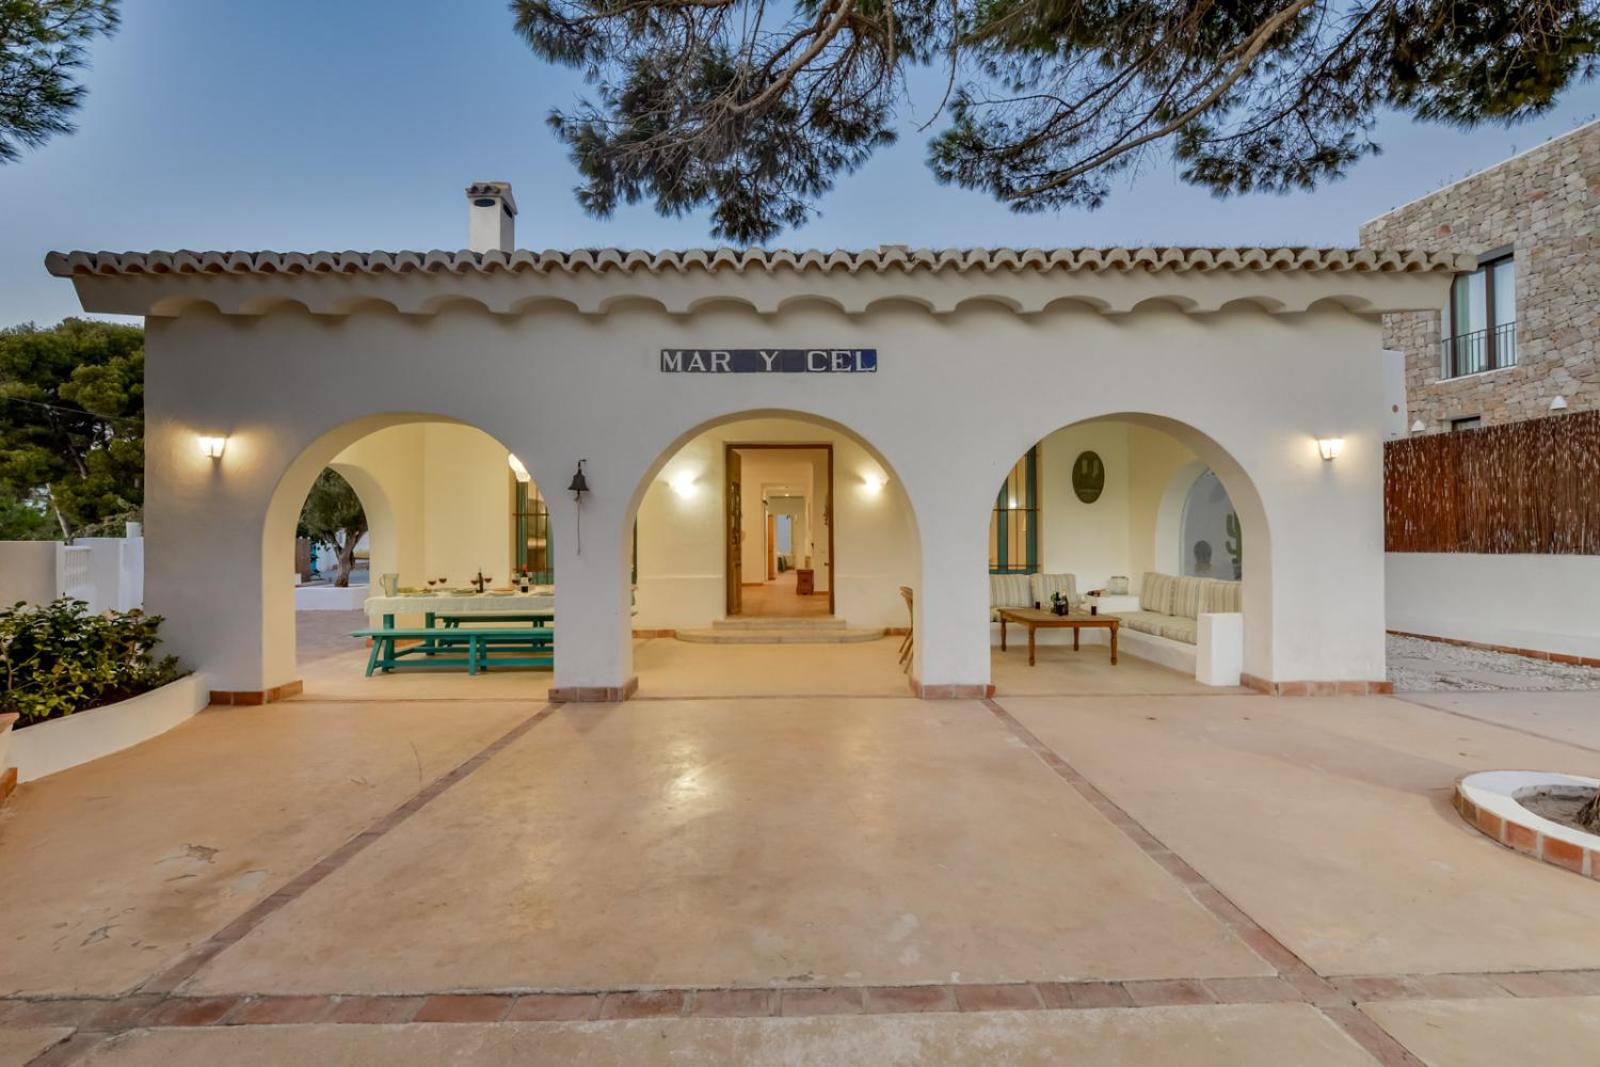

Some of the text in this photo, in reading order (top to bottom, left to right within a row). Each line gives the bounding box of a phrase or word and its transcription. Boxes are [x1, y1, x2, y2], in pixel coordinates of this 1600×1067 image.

[663, 350, 876, 372] MAR Y CEL
